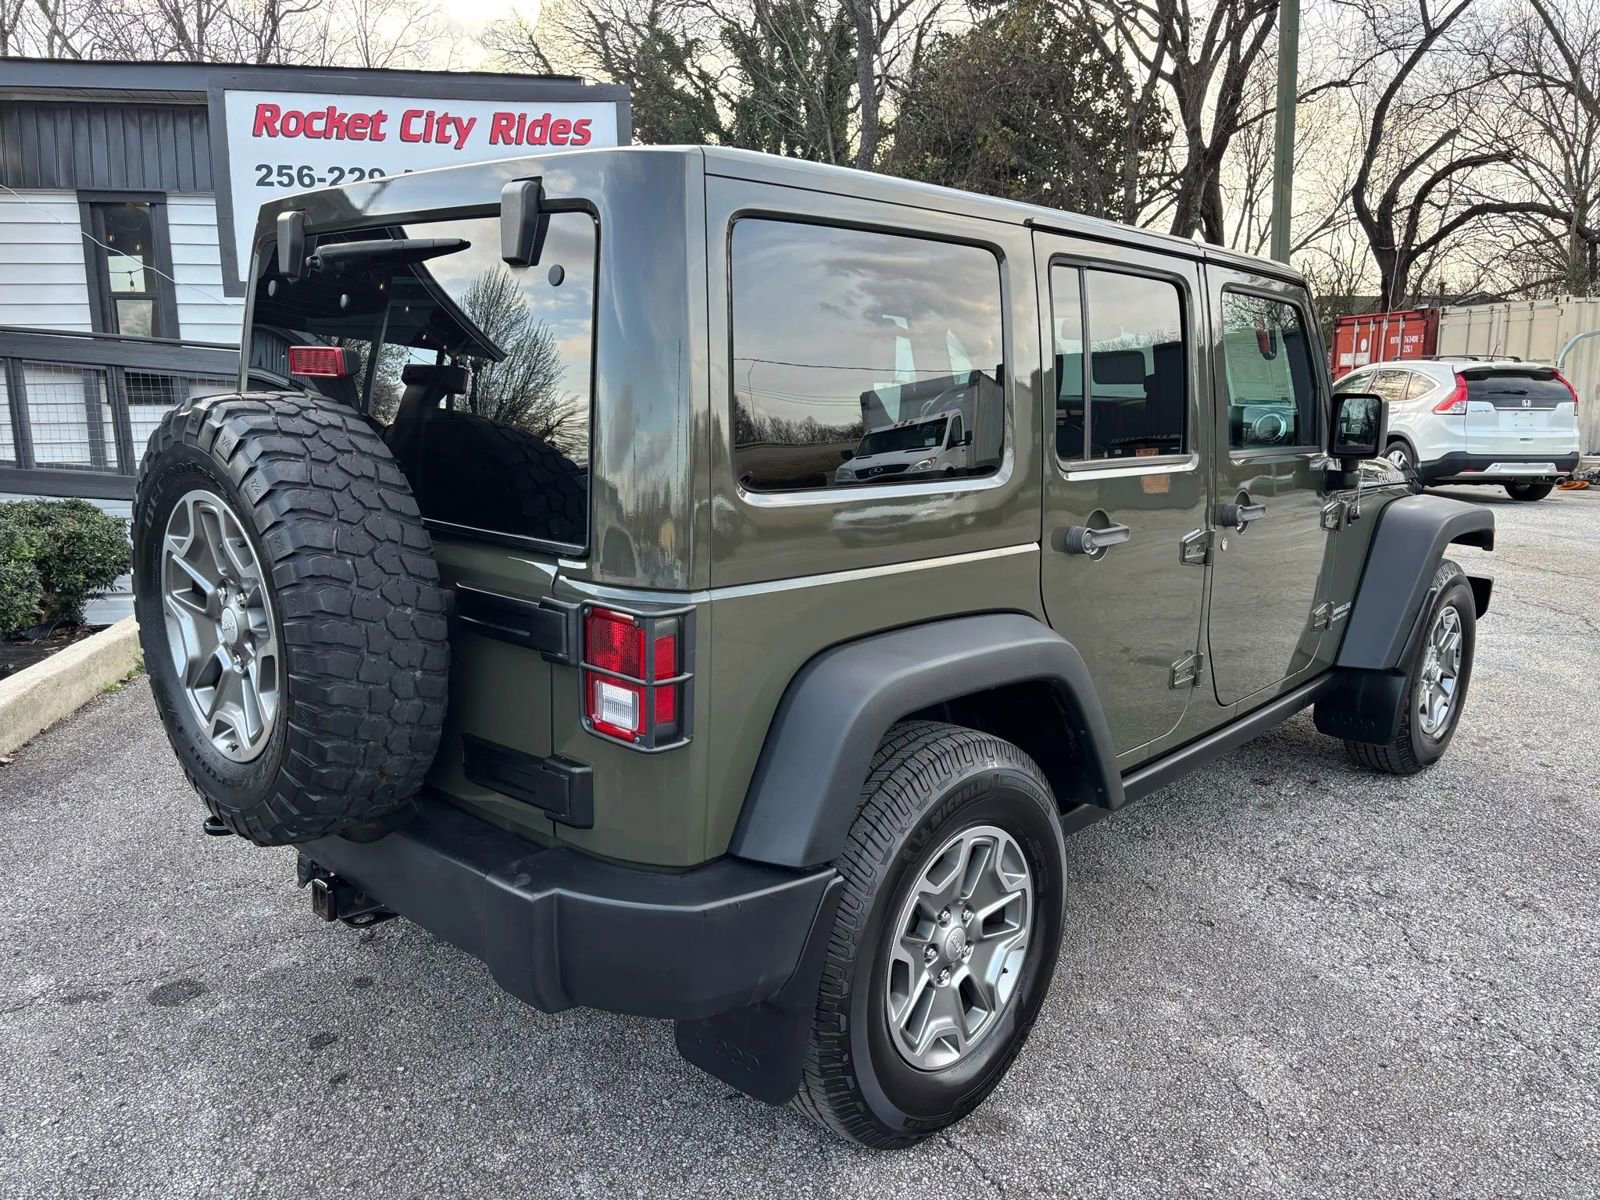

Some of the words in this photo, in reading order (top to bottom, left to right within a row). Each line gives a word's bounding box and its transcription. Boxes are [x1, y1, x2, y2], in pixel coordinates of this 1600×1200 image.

[252, 103, 388, 142] Rocket
[400, 109, 477, 150] City
[489, 111, 592, 146] Rides
